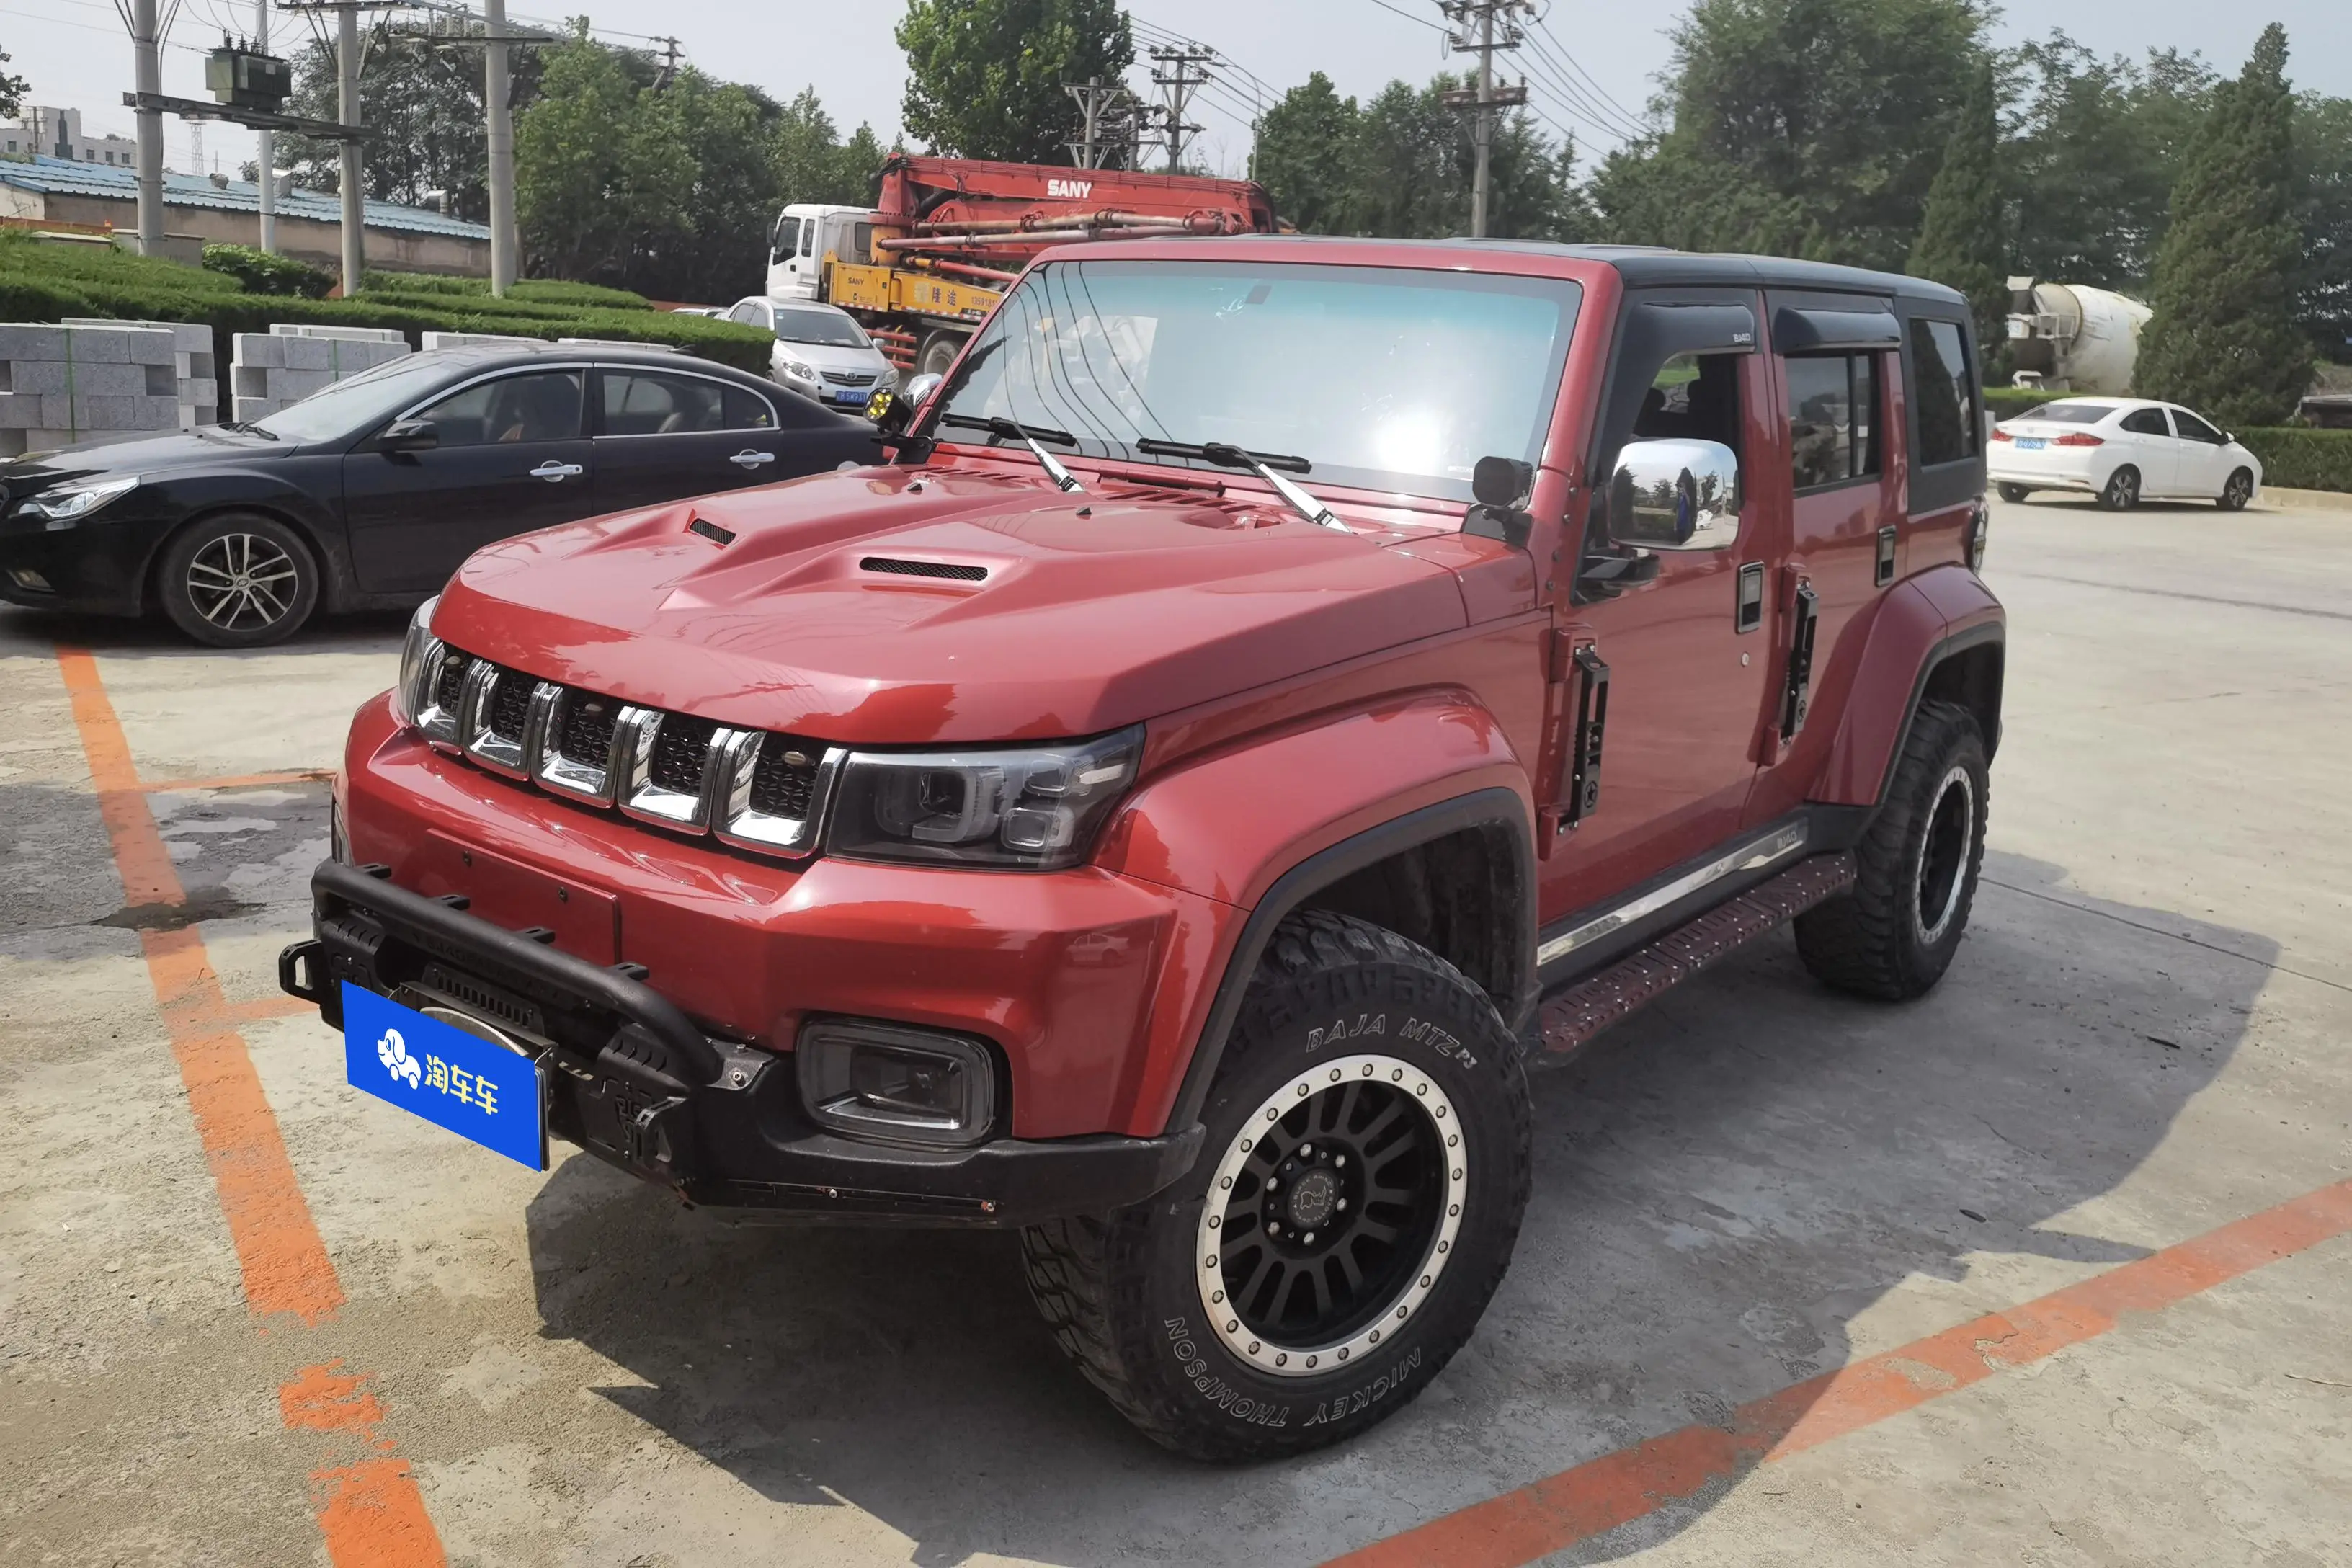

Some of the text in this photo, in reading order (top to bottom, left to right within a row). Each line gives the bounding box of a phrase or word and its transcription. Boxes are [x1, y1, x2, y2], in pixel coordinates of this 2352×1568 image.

[1047, 179, 1092, 199] SANY
[1306, 1013, 1386, 1053] BAJA
[1399, 1017, 1461, 1057] MTZ
[1164, 1316, 1422, 1427] MICKEY THOMPSON
